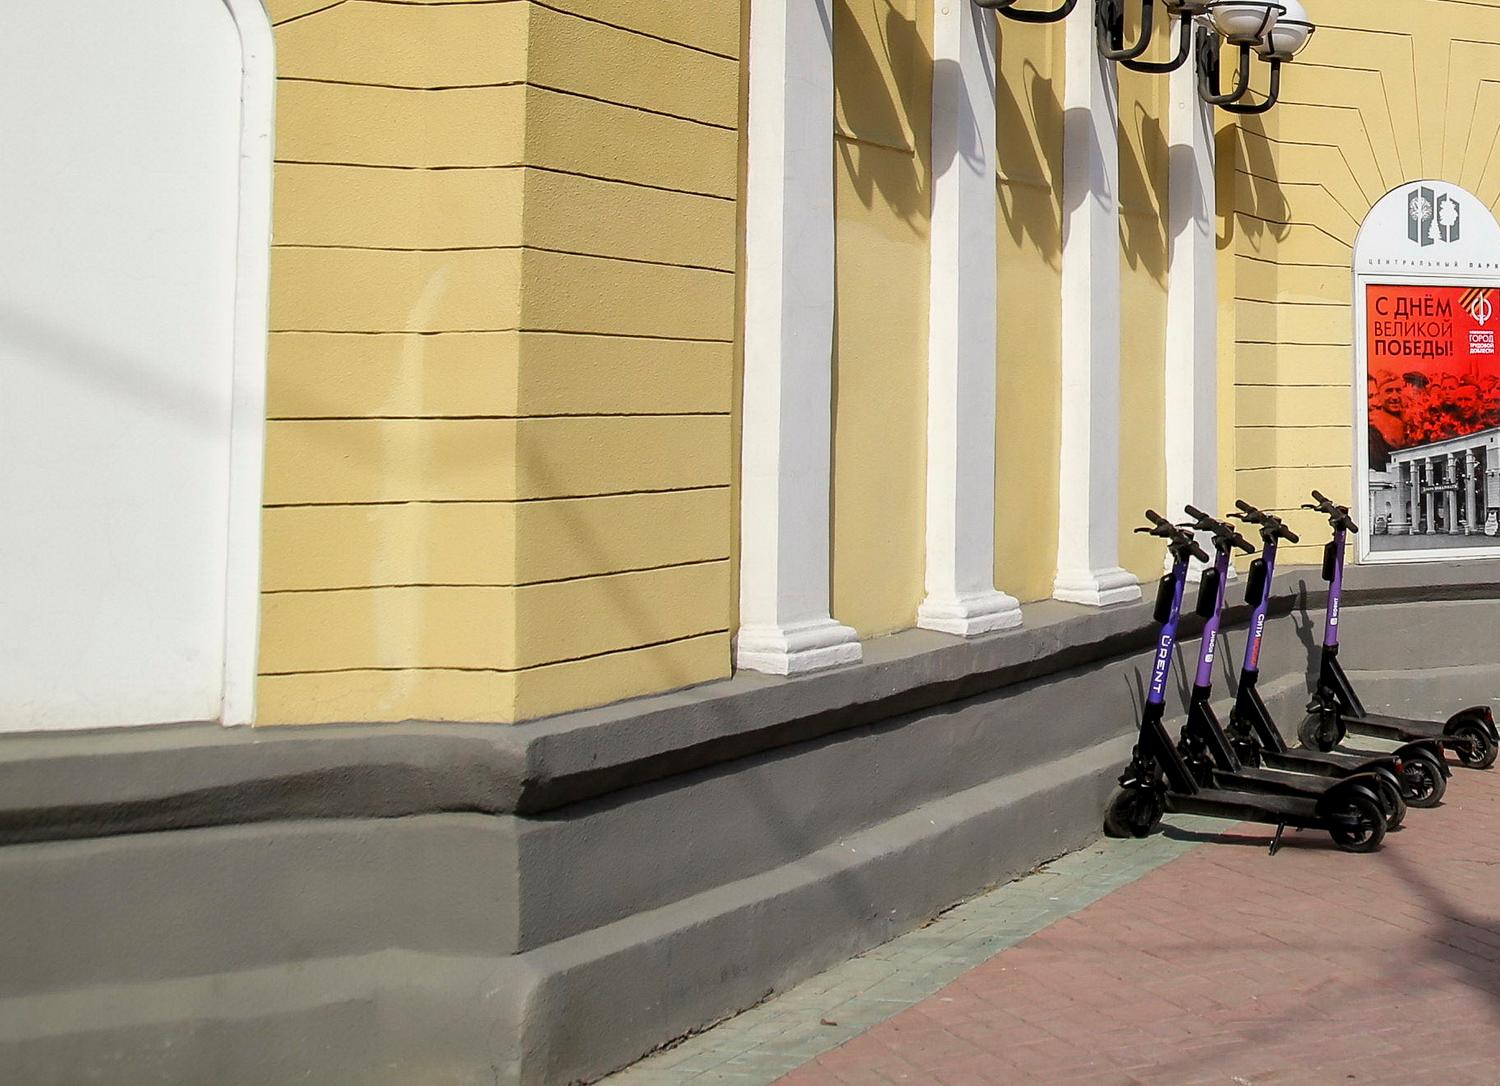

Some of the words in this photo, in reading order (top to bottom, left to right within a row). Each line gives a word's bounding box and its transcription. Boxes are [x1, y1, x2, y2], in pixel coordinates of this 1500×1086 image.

[1376, 296, 1389, 316] С
[1394, 294, 1452, 320] ДНЁМ
[1375, 319, 1453, 338] ВЕЛИКОЙ
[1375, 340, 1453, 359] ПОБЕДЫ!
